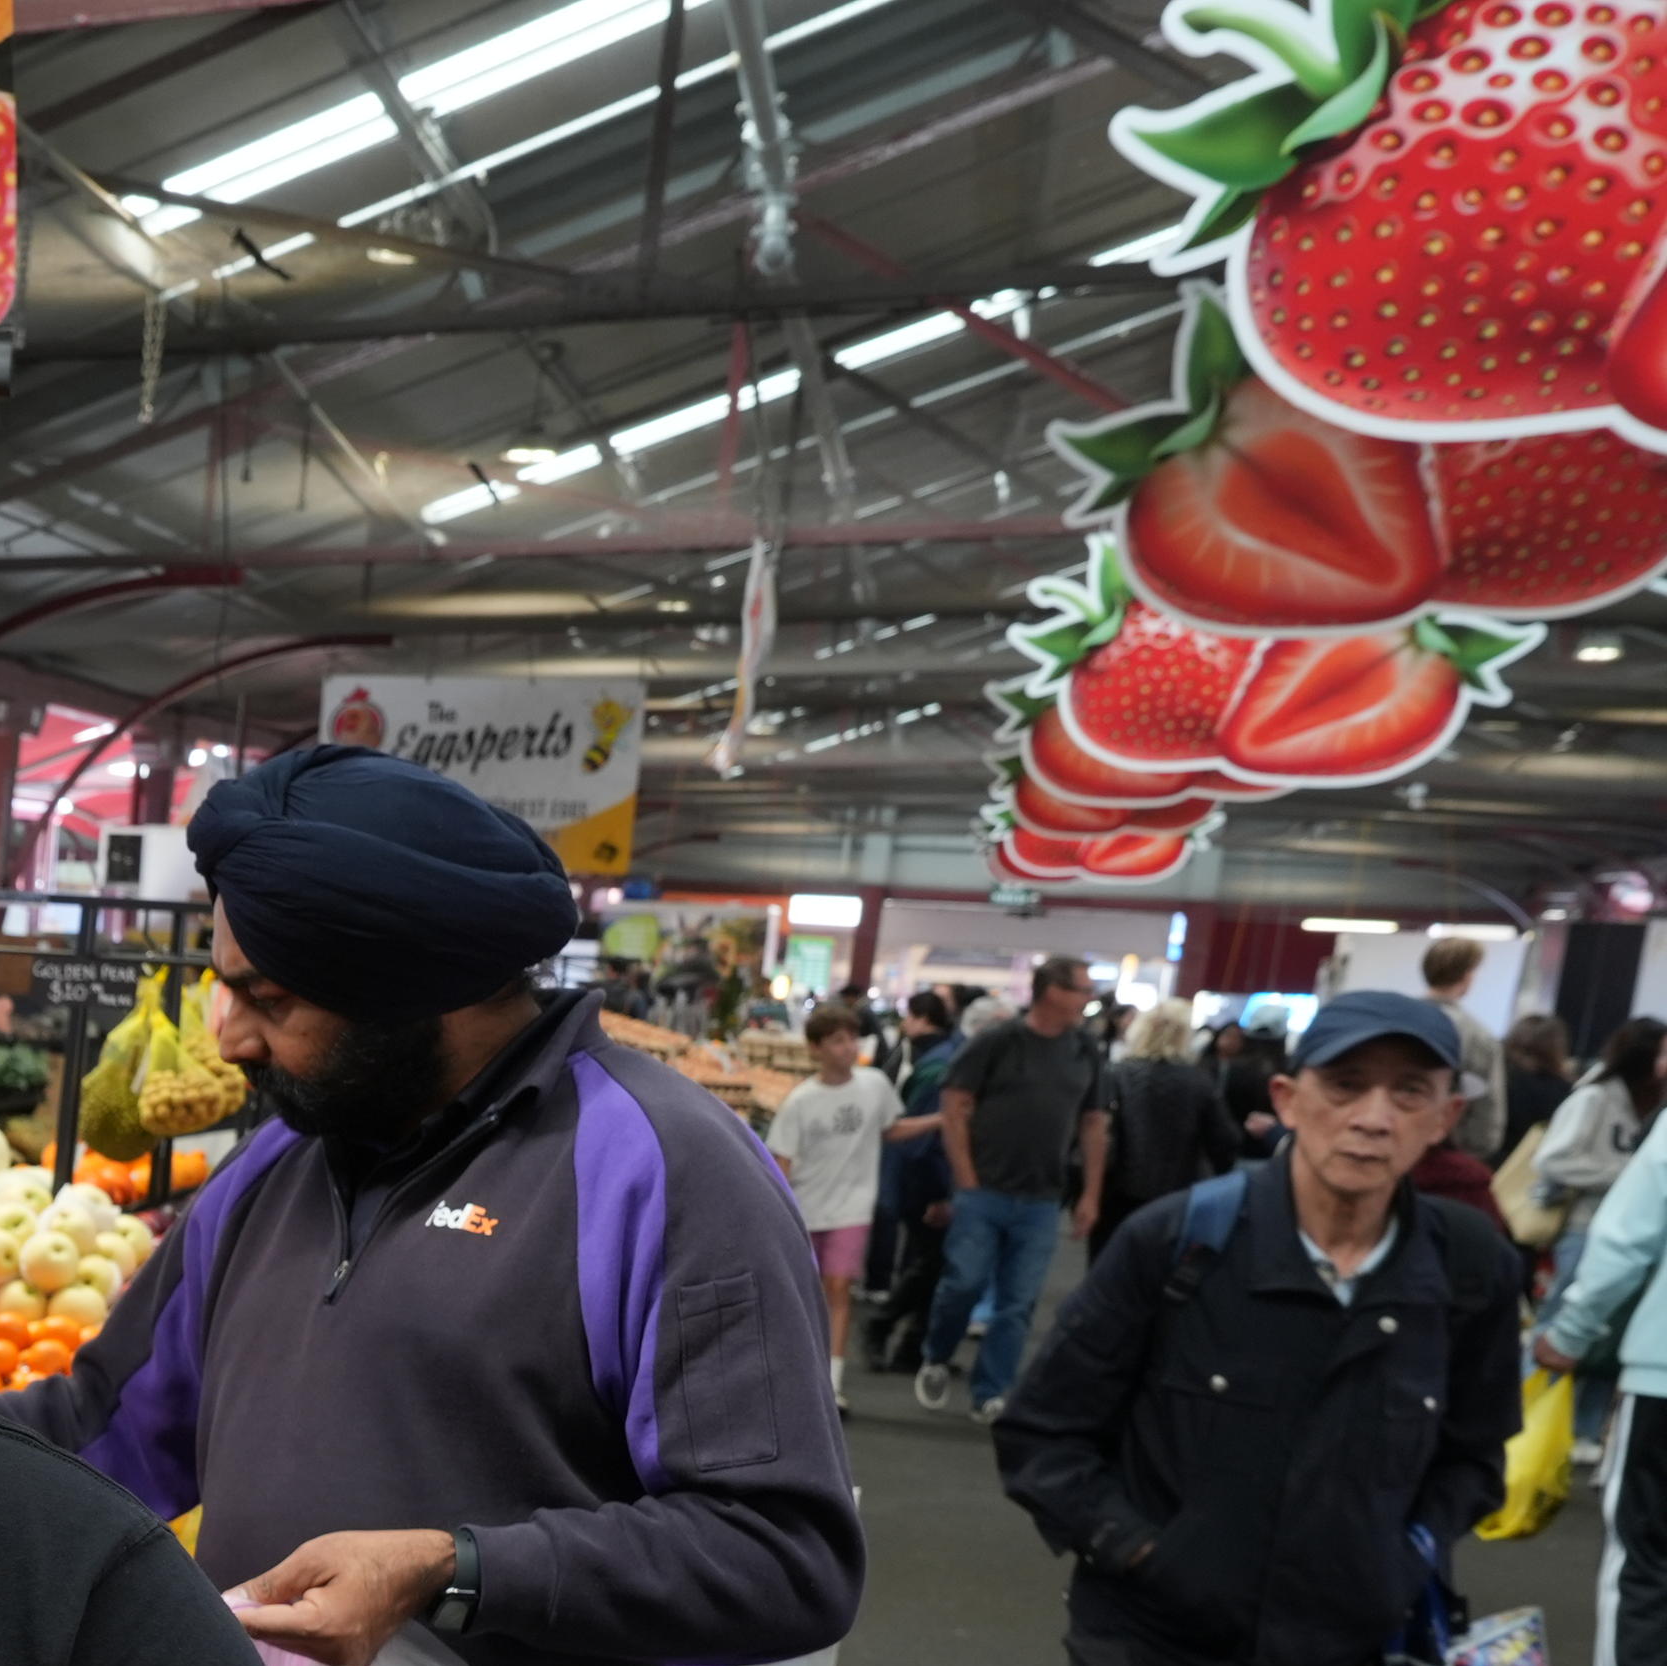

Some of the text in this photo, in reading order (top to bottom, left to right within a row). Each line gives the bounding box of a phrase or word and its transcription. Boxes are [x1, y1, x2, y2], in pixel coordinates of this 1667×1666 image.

[427, 699, 457, 724] The
[394, 708, 572, 774] Eggsperts
[32, 959, 136, 983] GOLDEN PEAR
